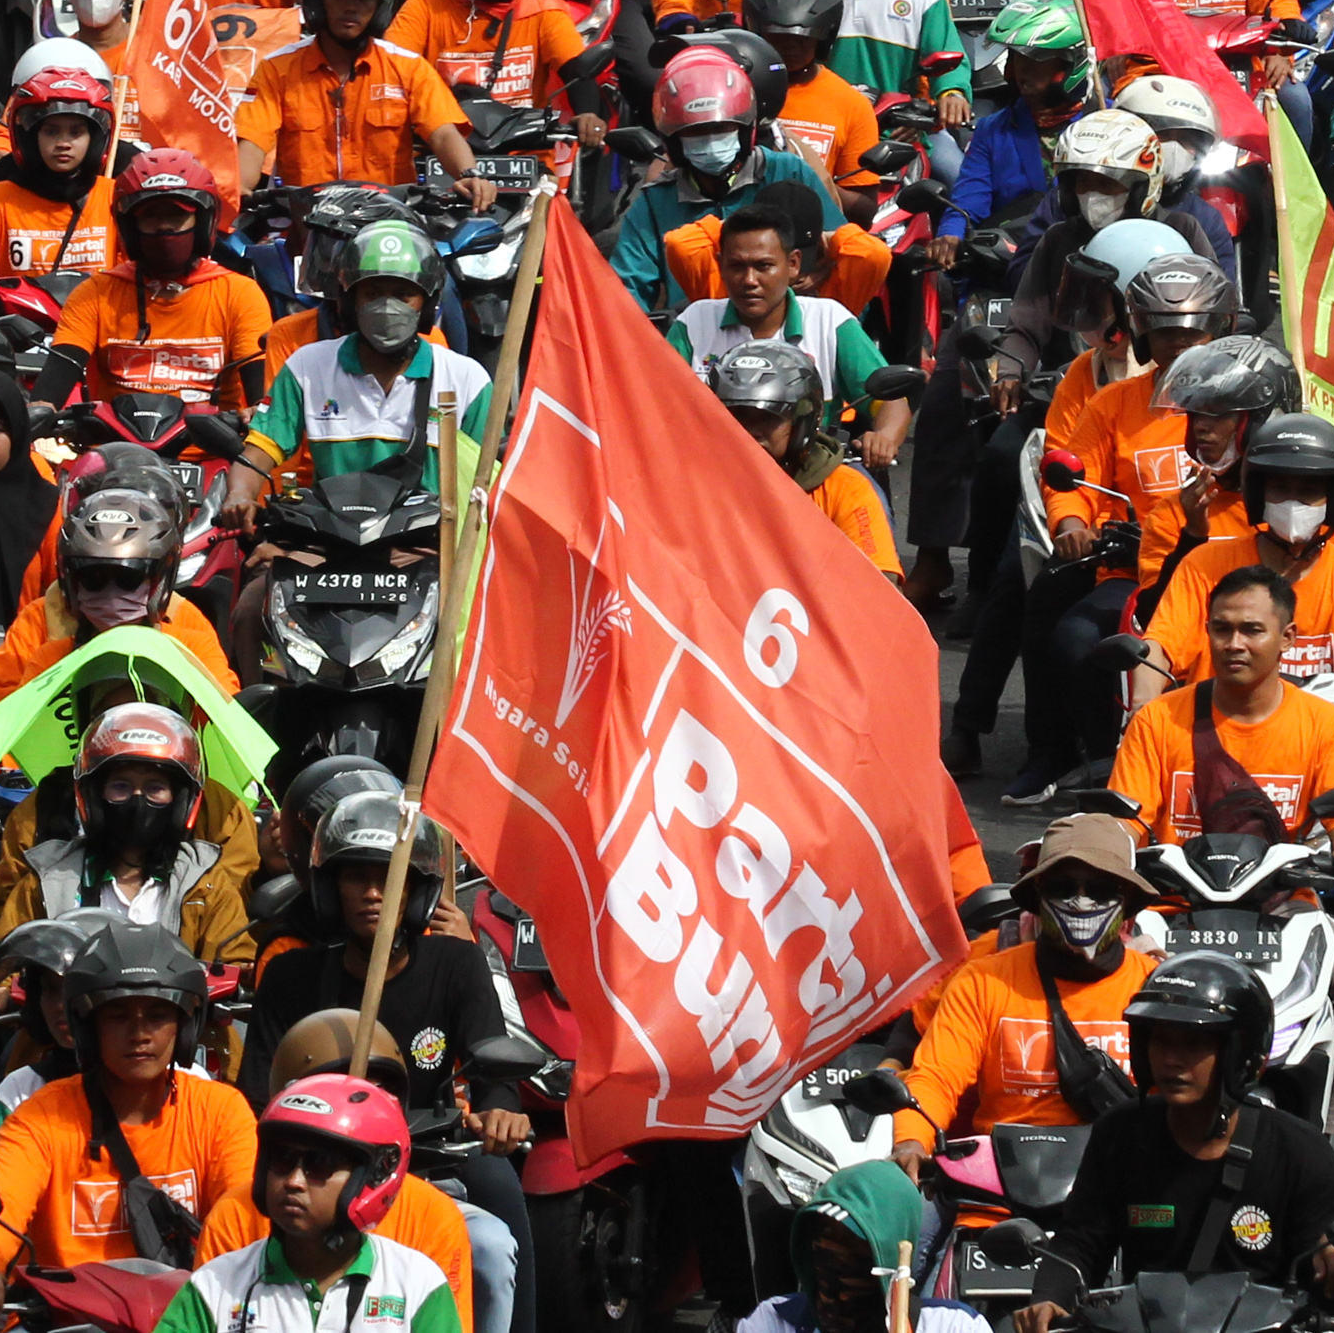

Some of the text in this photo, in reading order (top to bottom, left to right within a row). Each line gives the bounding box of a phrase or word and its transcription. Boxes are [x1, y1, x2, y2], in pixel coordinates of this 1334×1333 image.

[1075, 130, 1108, 142] CABERG
[432, 160, 532, 176] S ML
[9, 242, 24, 264] 6
[61, 250, 105, 266] Buruh
[1157, 272, 1193, 282] INK
[154, 347, 222, 370] Partai
[152, 363, 218, 381] Buruh
[132, 411, 162, 419] HONDA
[342, 504, 377, 514] HONDA
[295, 572, 412, 589] W 4378 NCR
[743, 587, 810, 689] 6
[483, 674, 550, 749] Negara
[122, 730, 164, 743] INK
[351, 829, 393, 843] INK
[652, 708, 893, 1054] Partai
[1165, 930, 1279, 947] L 3830 IK
[120, 966, 158, 975] HONDA
[606, 811, 792, 1129] Buruh
[410, 1046, 446, 1064] TOLAK
[284, 1095, 326, 1111] INK
[1019, 1134, 1067, 1144] HONDA
[1230, 1220, 1273, 1241] TOLAK
